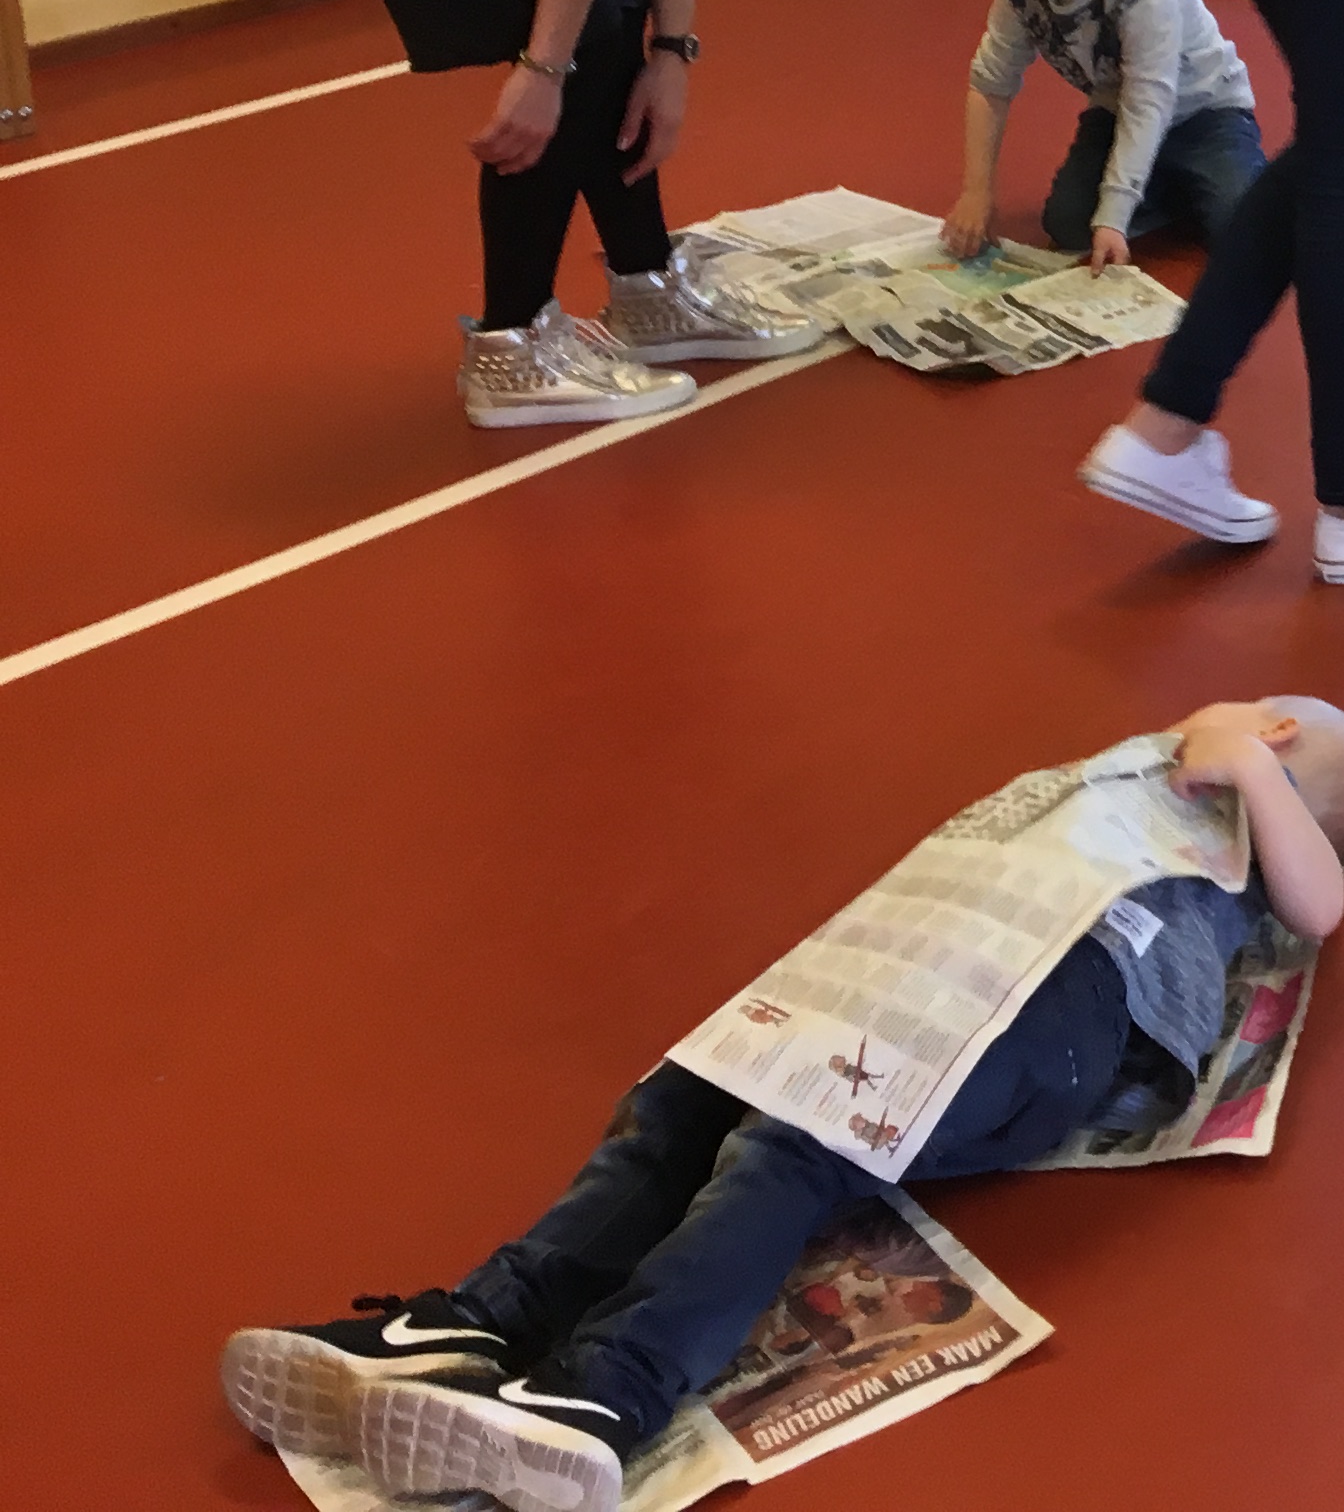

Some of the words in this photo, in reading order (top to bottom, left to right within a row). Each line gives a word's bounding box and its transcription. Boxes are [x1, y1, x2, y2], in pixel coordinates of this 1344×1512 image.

[936, 1325, 1004, 1367] MAAK
[891, 1355, 936, 1386] EEN
[752, 1376, 889, 1451] WANDELING
